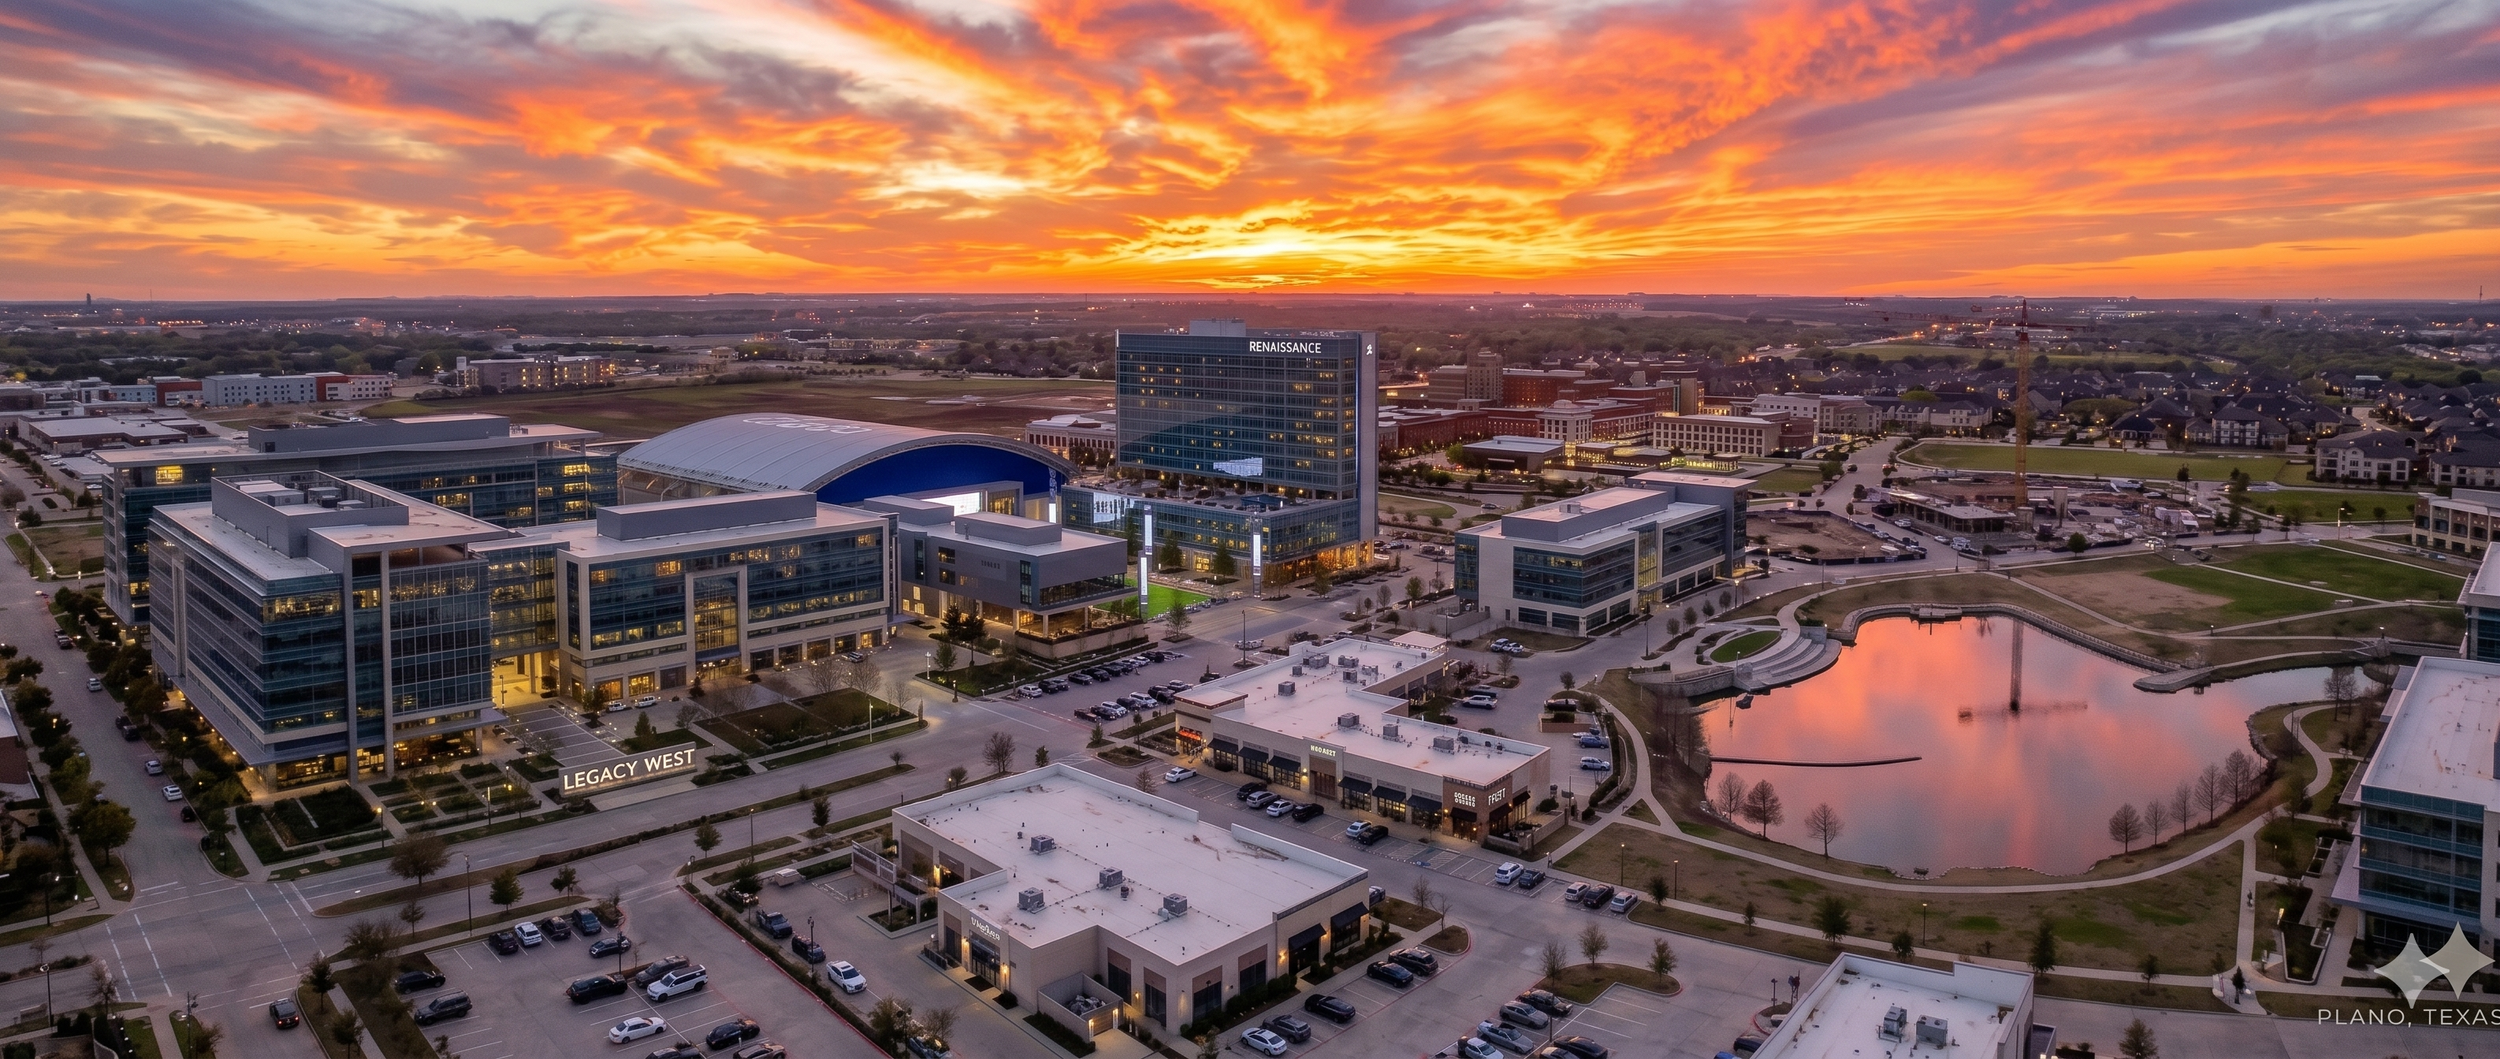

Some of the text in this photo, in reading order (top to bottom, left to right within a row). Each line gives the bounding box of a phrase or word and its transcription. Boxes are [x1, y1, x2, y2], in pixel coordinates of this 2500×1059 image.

[1249, 341, 1322, 354] RENAISSANCE
[563, 748, 695, 790] LEGACY WEST
